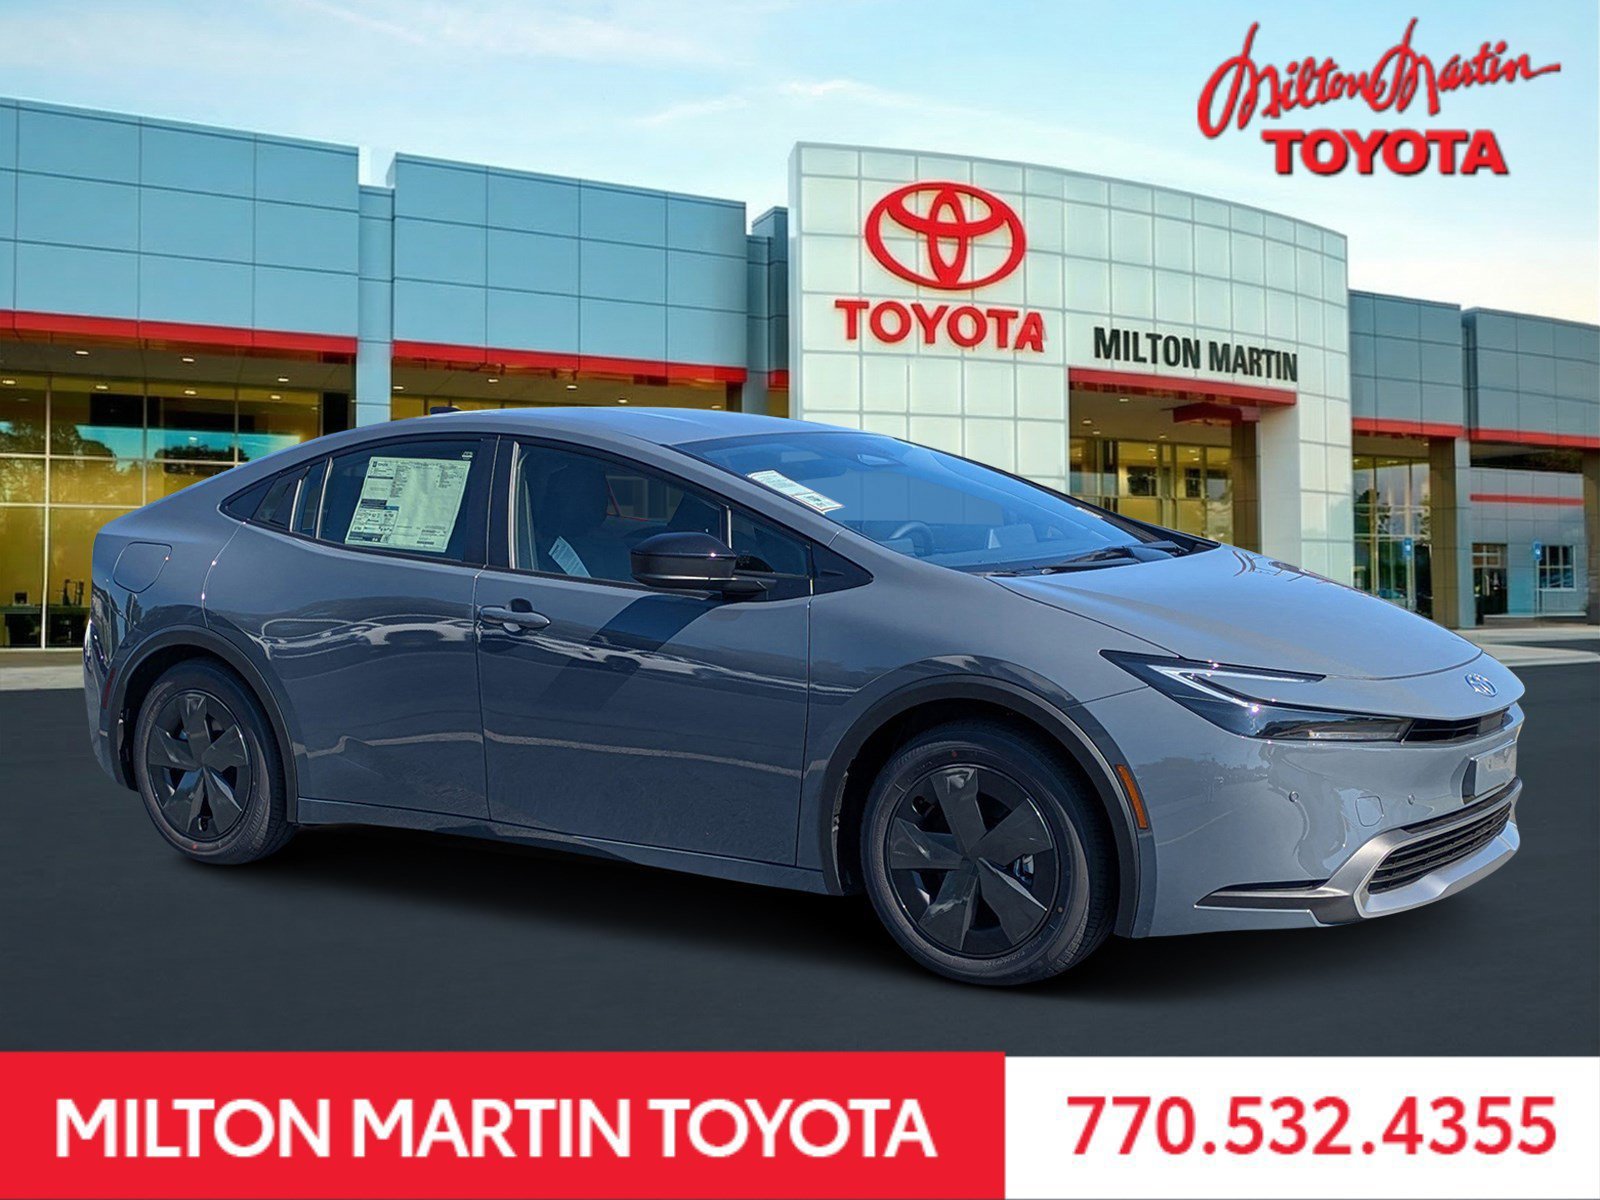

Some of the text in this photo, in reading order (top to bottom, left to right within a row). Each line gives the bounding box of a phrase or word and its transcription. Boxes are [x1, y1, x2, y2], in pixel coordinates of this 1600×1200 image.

[835, 299, 1046, 353] TOYOTA
[1093, 326, 1298, 382] MILTON MARTIN
